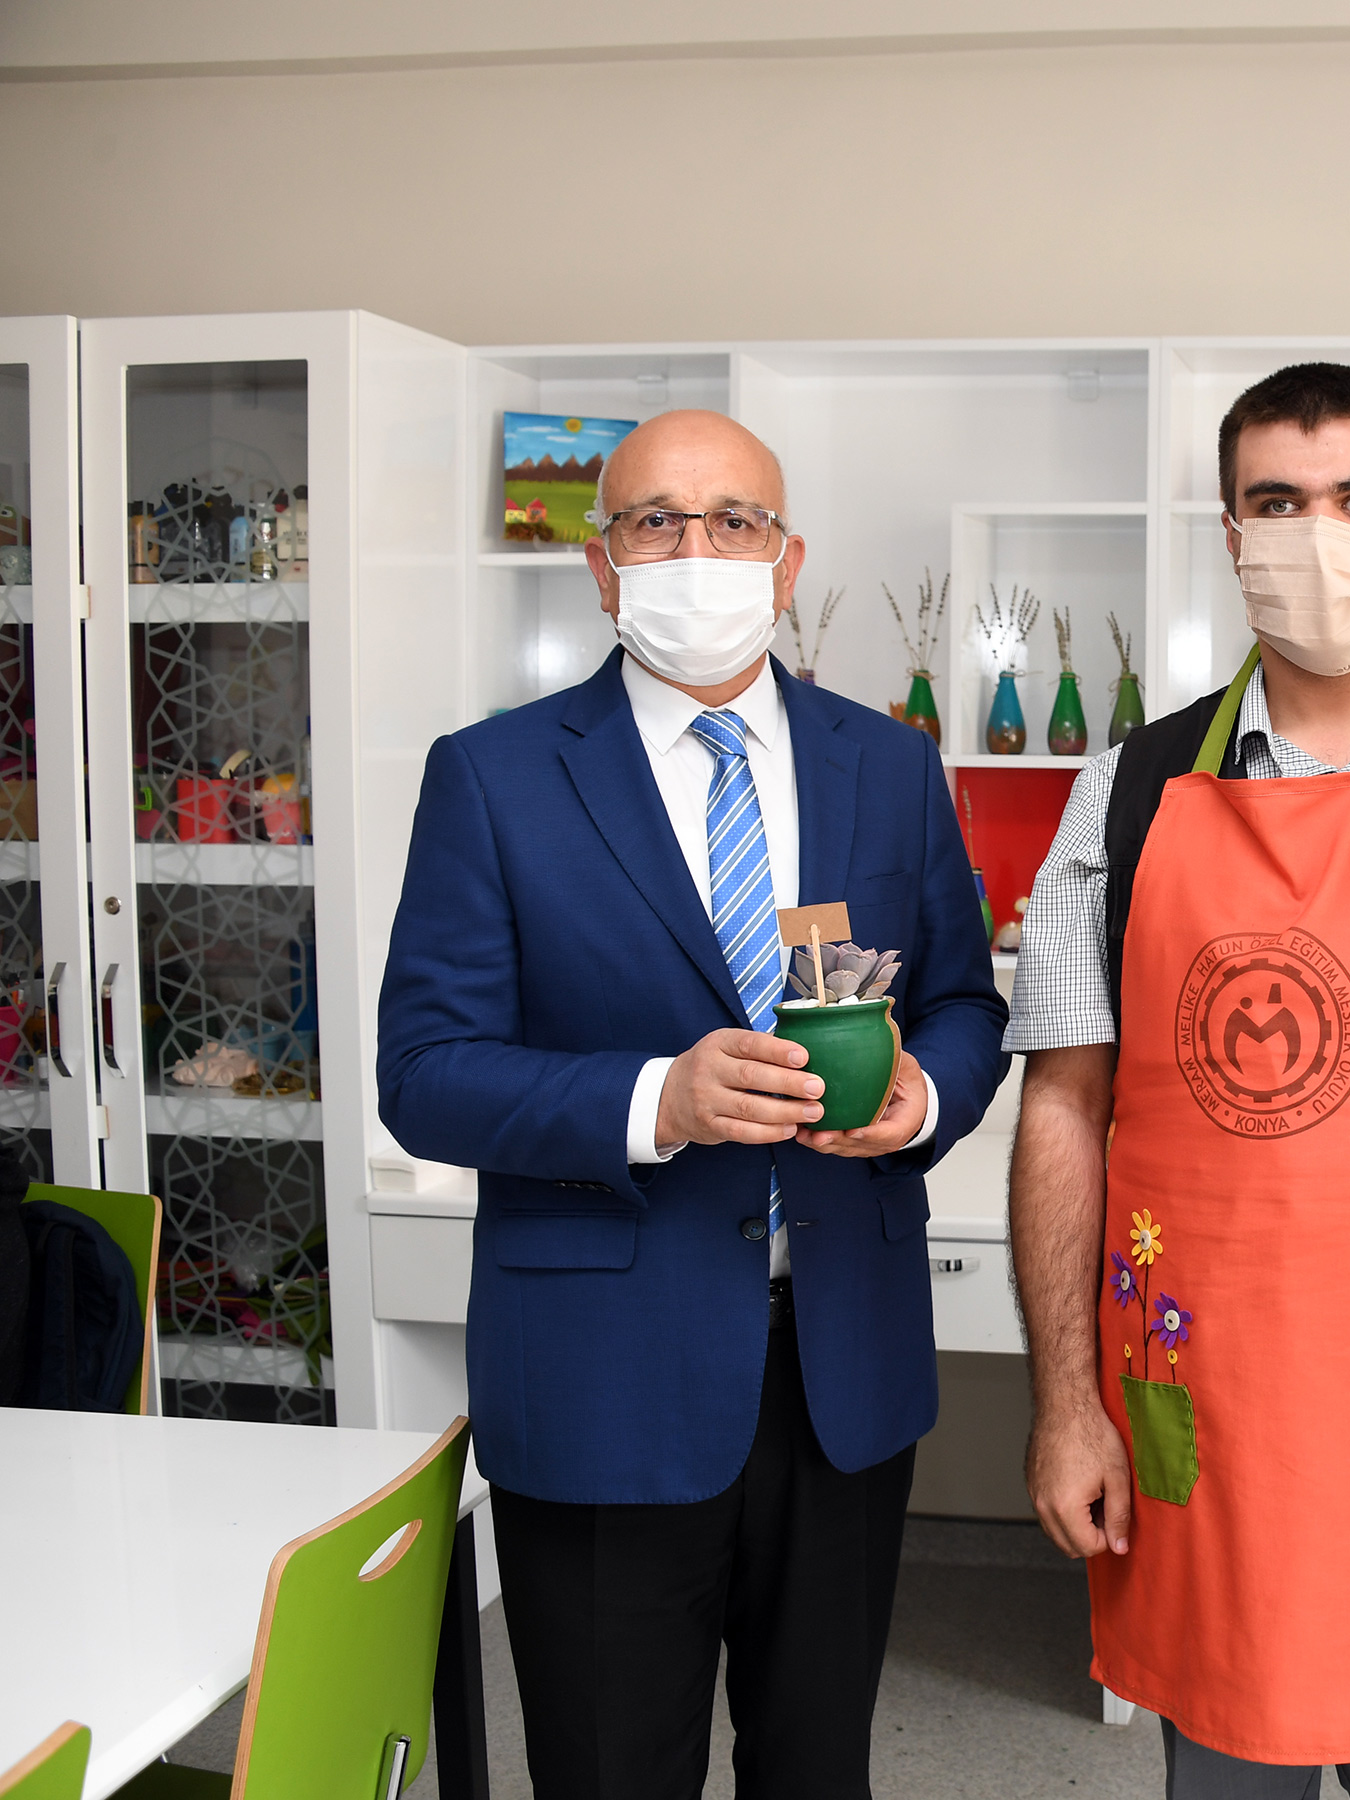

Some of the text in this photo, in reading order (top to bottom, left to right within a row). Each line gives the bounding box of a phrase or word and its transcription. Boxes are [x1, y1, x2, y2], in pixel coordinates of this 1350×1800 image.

[1196, 940, 1243, 978] HATUN
[1289, 935, 1340, 984] EĞİTİM
[1181, 982, 1200, 1046] MELİKE
[1183, 1057, 1220, 1112] MERAM
[1234, 1114, 1290, 1133] KONYA
